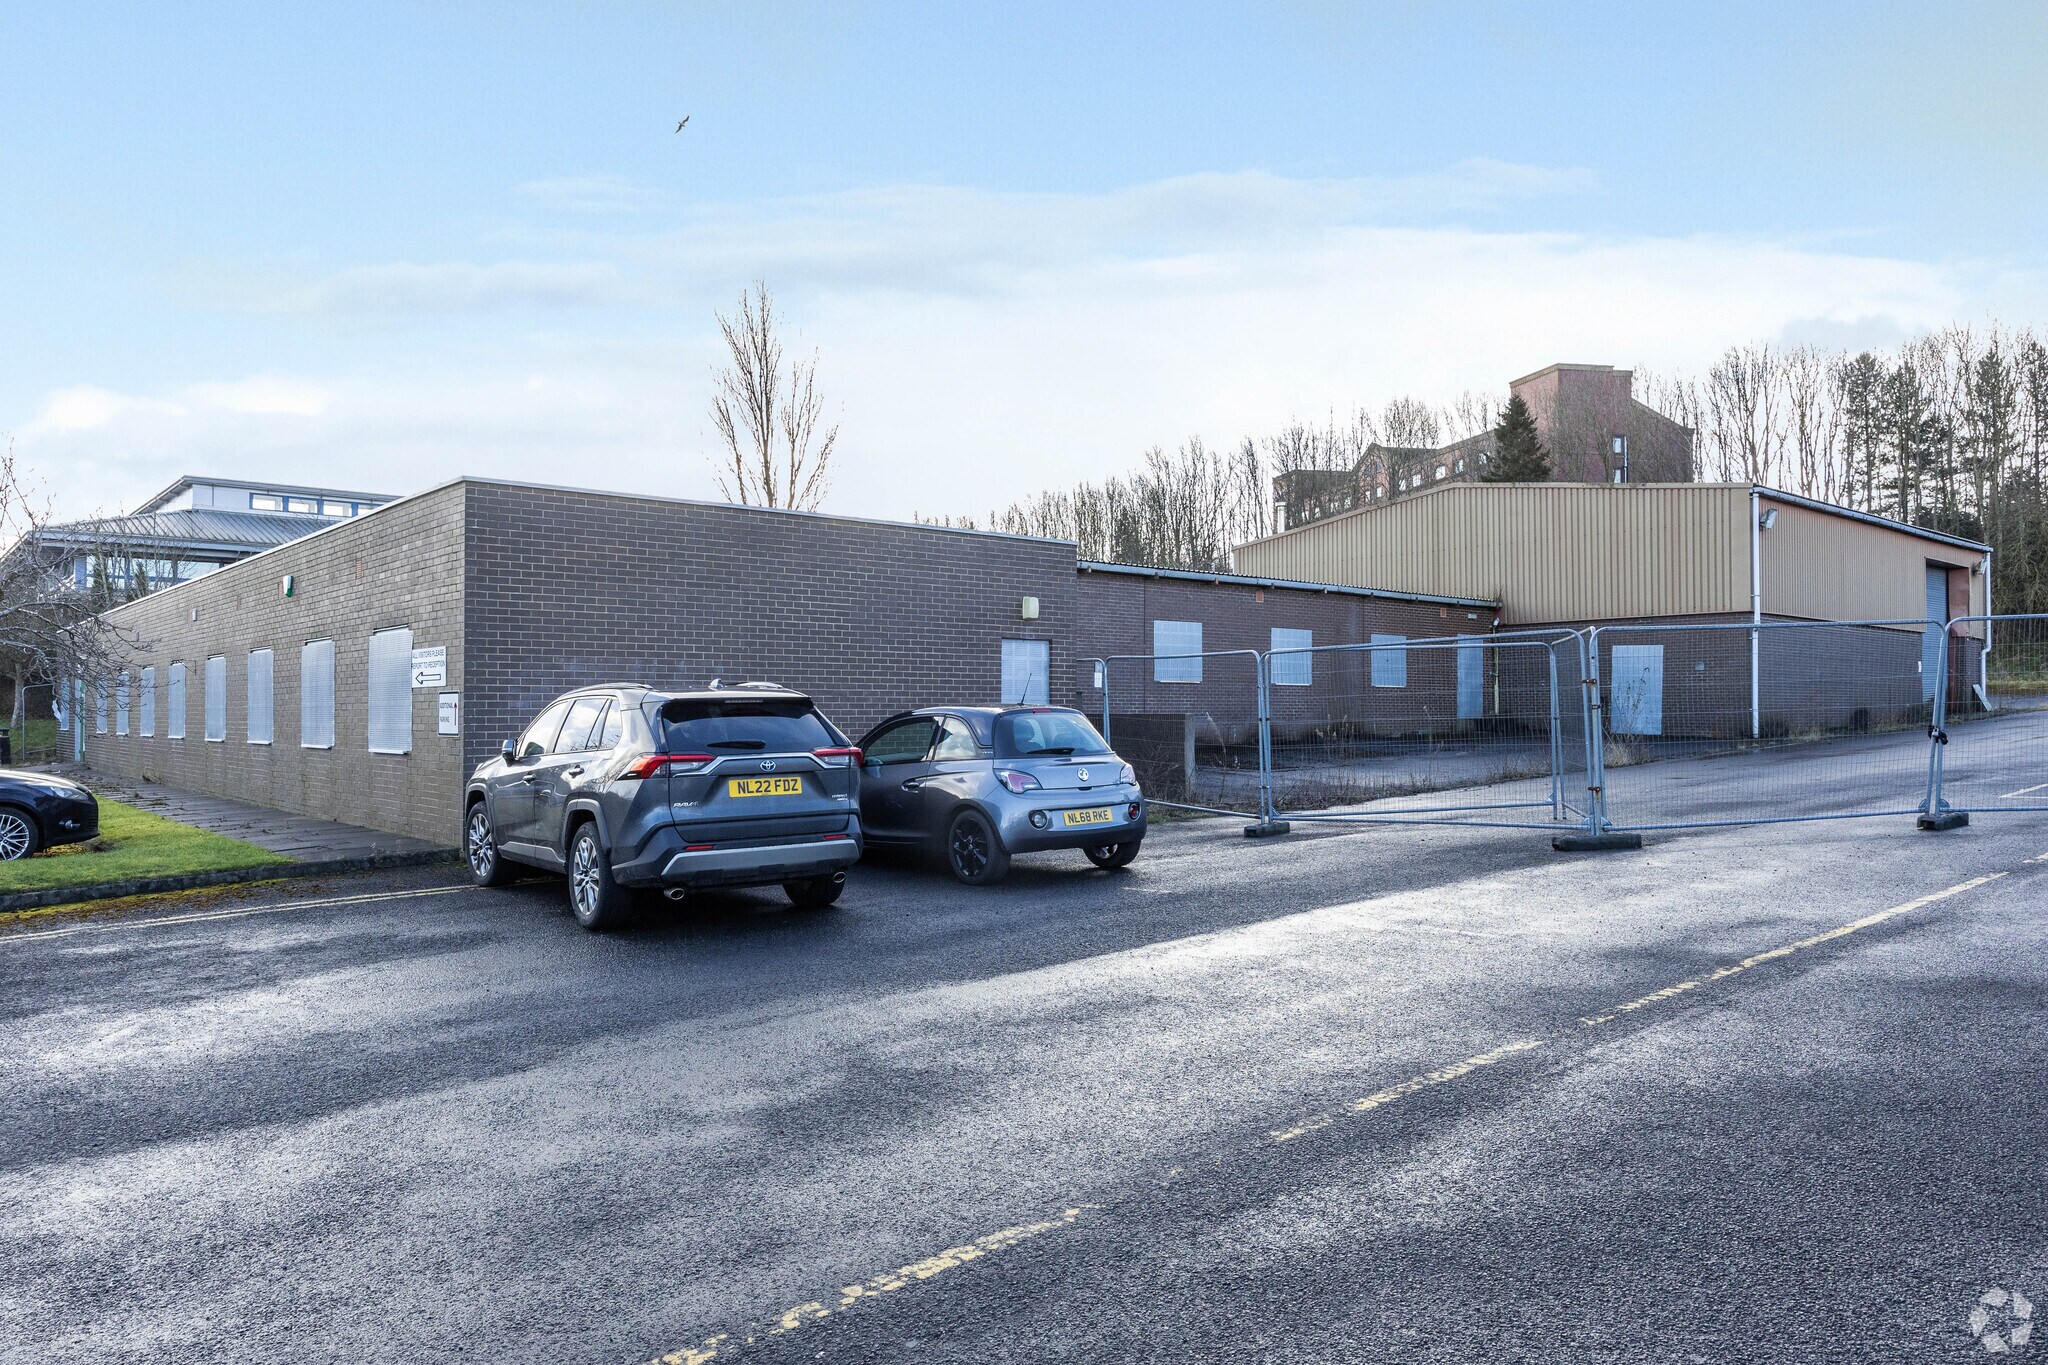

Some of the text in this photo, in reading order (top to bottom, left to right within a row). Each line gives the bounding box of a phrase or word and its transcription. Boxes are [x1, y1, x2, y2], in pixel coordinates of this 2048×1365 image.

[432, 648, 444, 657] PLEASE
[428, 660, 445, 669] RECEPTION
[737, 779, 798, 794] NL22 FDZ
[1067, 810, 1109, 823] NL68 RKE
